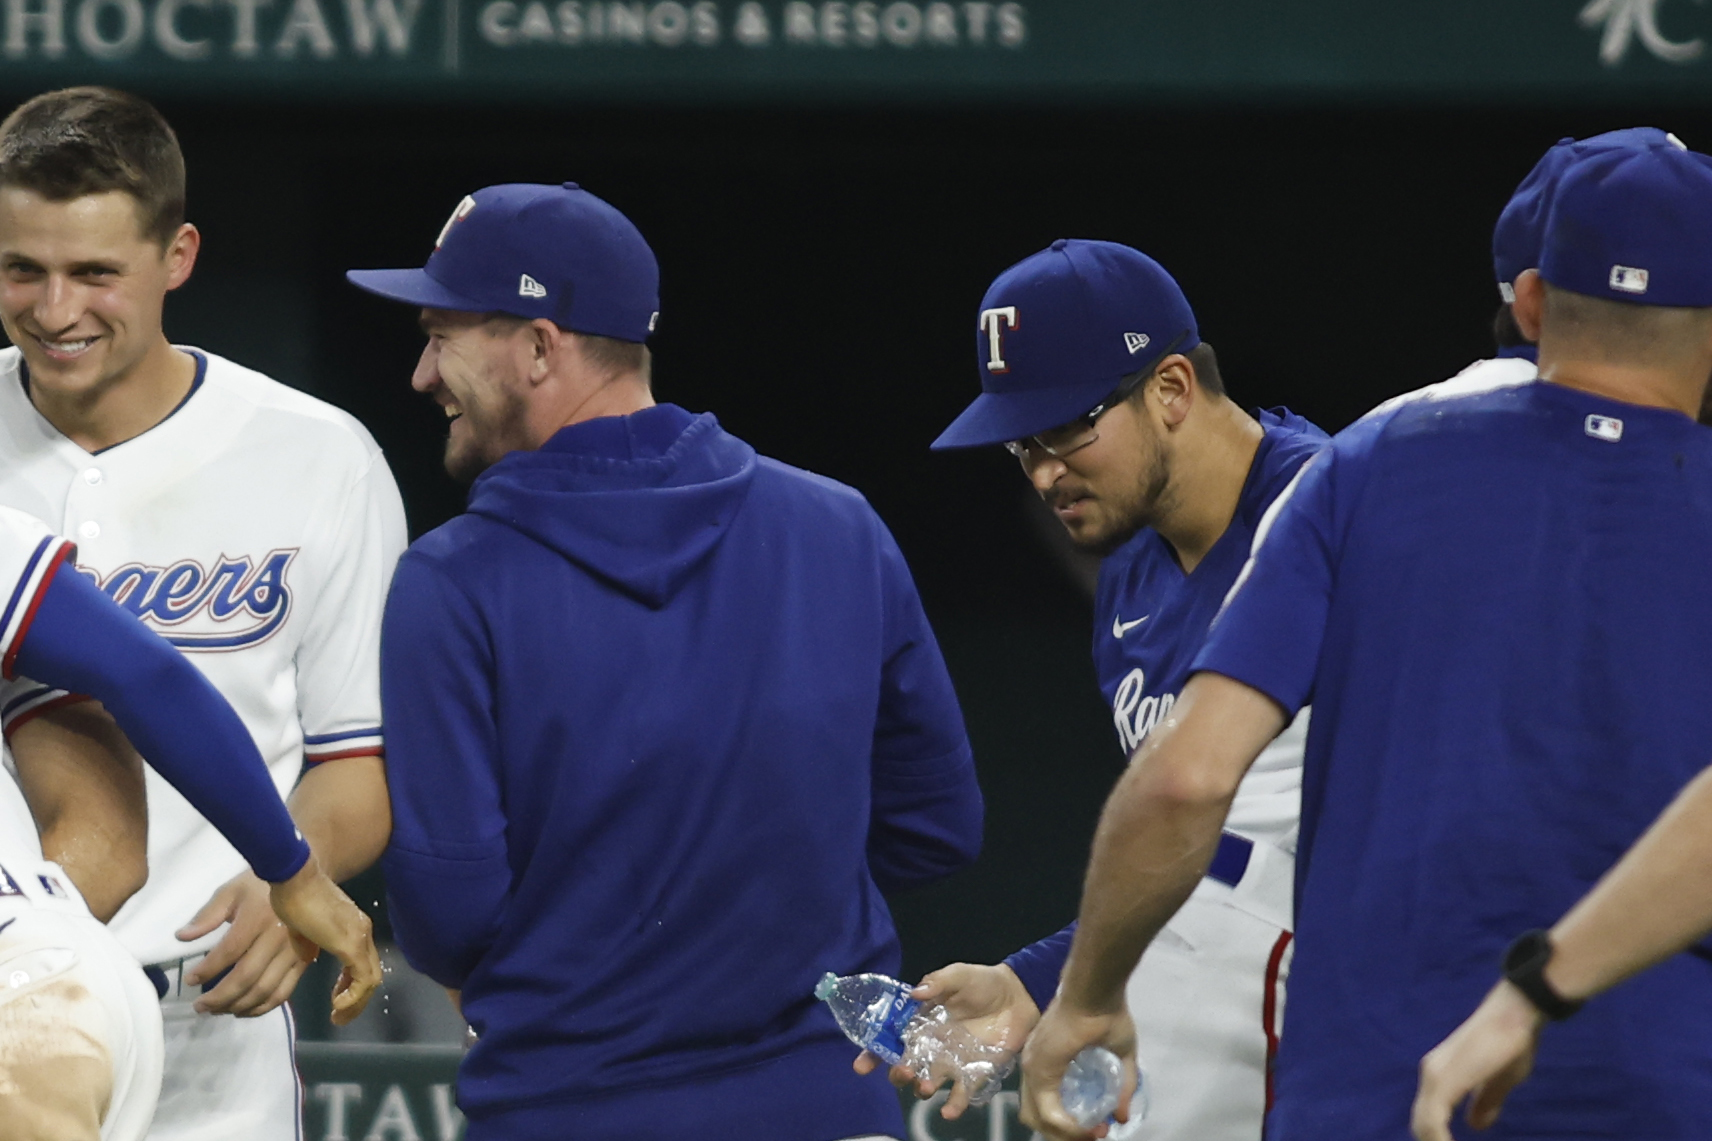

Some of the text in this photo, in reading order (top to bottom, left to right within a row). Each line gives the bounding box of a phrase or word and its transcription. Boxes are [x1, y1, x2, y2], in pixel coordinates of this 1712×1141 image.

[478, 0, 720, 47] CASINOS
[784, 0, 1027, 47] RESORTS
[980, 305, 1020, 374] T
